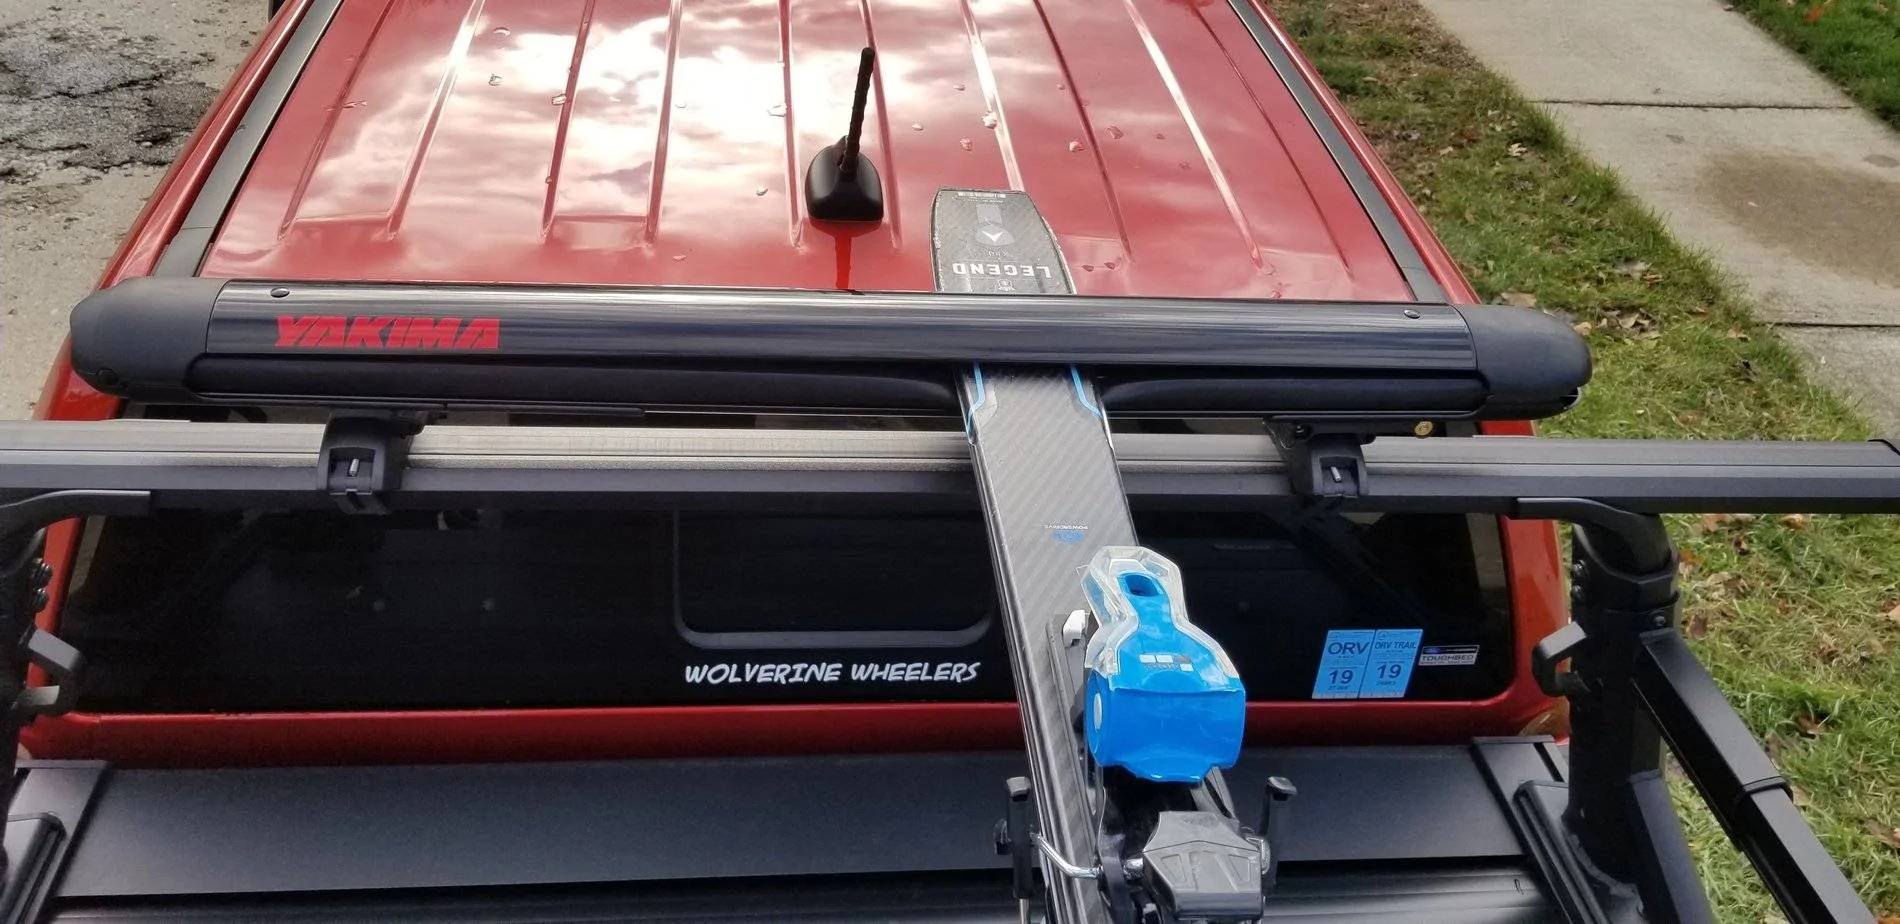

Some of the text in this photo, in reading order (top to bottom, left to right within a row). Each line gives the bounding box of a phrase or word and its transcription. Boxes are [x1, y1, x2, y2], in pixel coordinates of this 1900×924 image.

[952, 263, 1052, 279] LEGEND
[275, 315, 499, 349] YAKIMA
[1328, 642, 1370, 654] ORV
[1375, 641, 1393, 649] ORV
[1394, 640, 1417, 649] TRAIL
[1422, 654, 1474, 662] TOUGHBED
[685, 662, 981, 684] WOLVERINE WHEELERS
[1329, 670, 1353, 685] 19
[1377, 664, 1402, 679] 19
